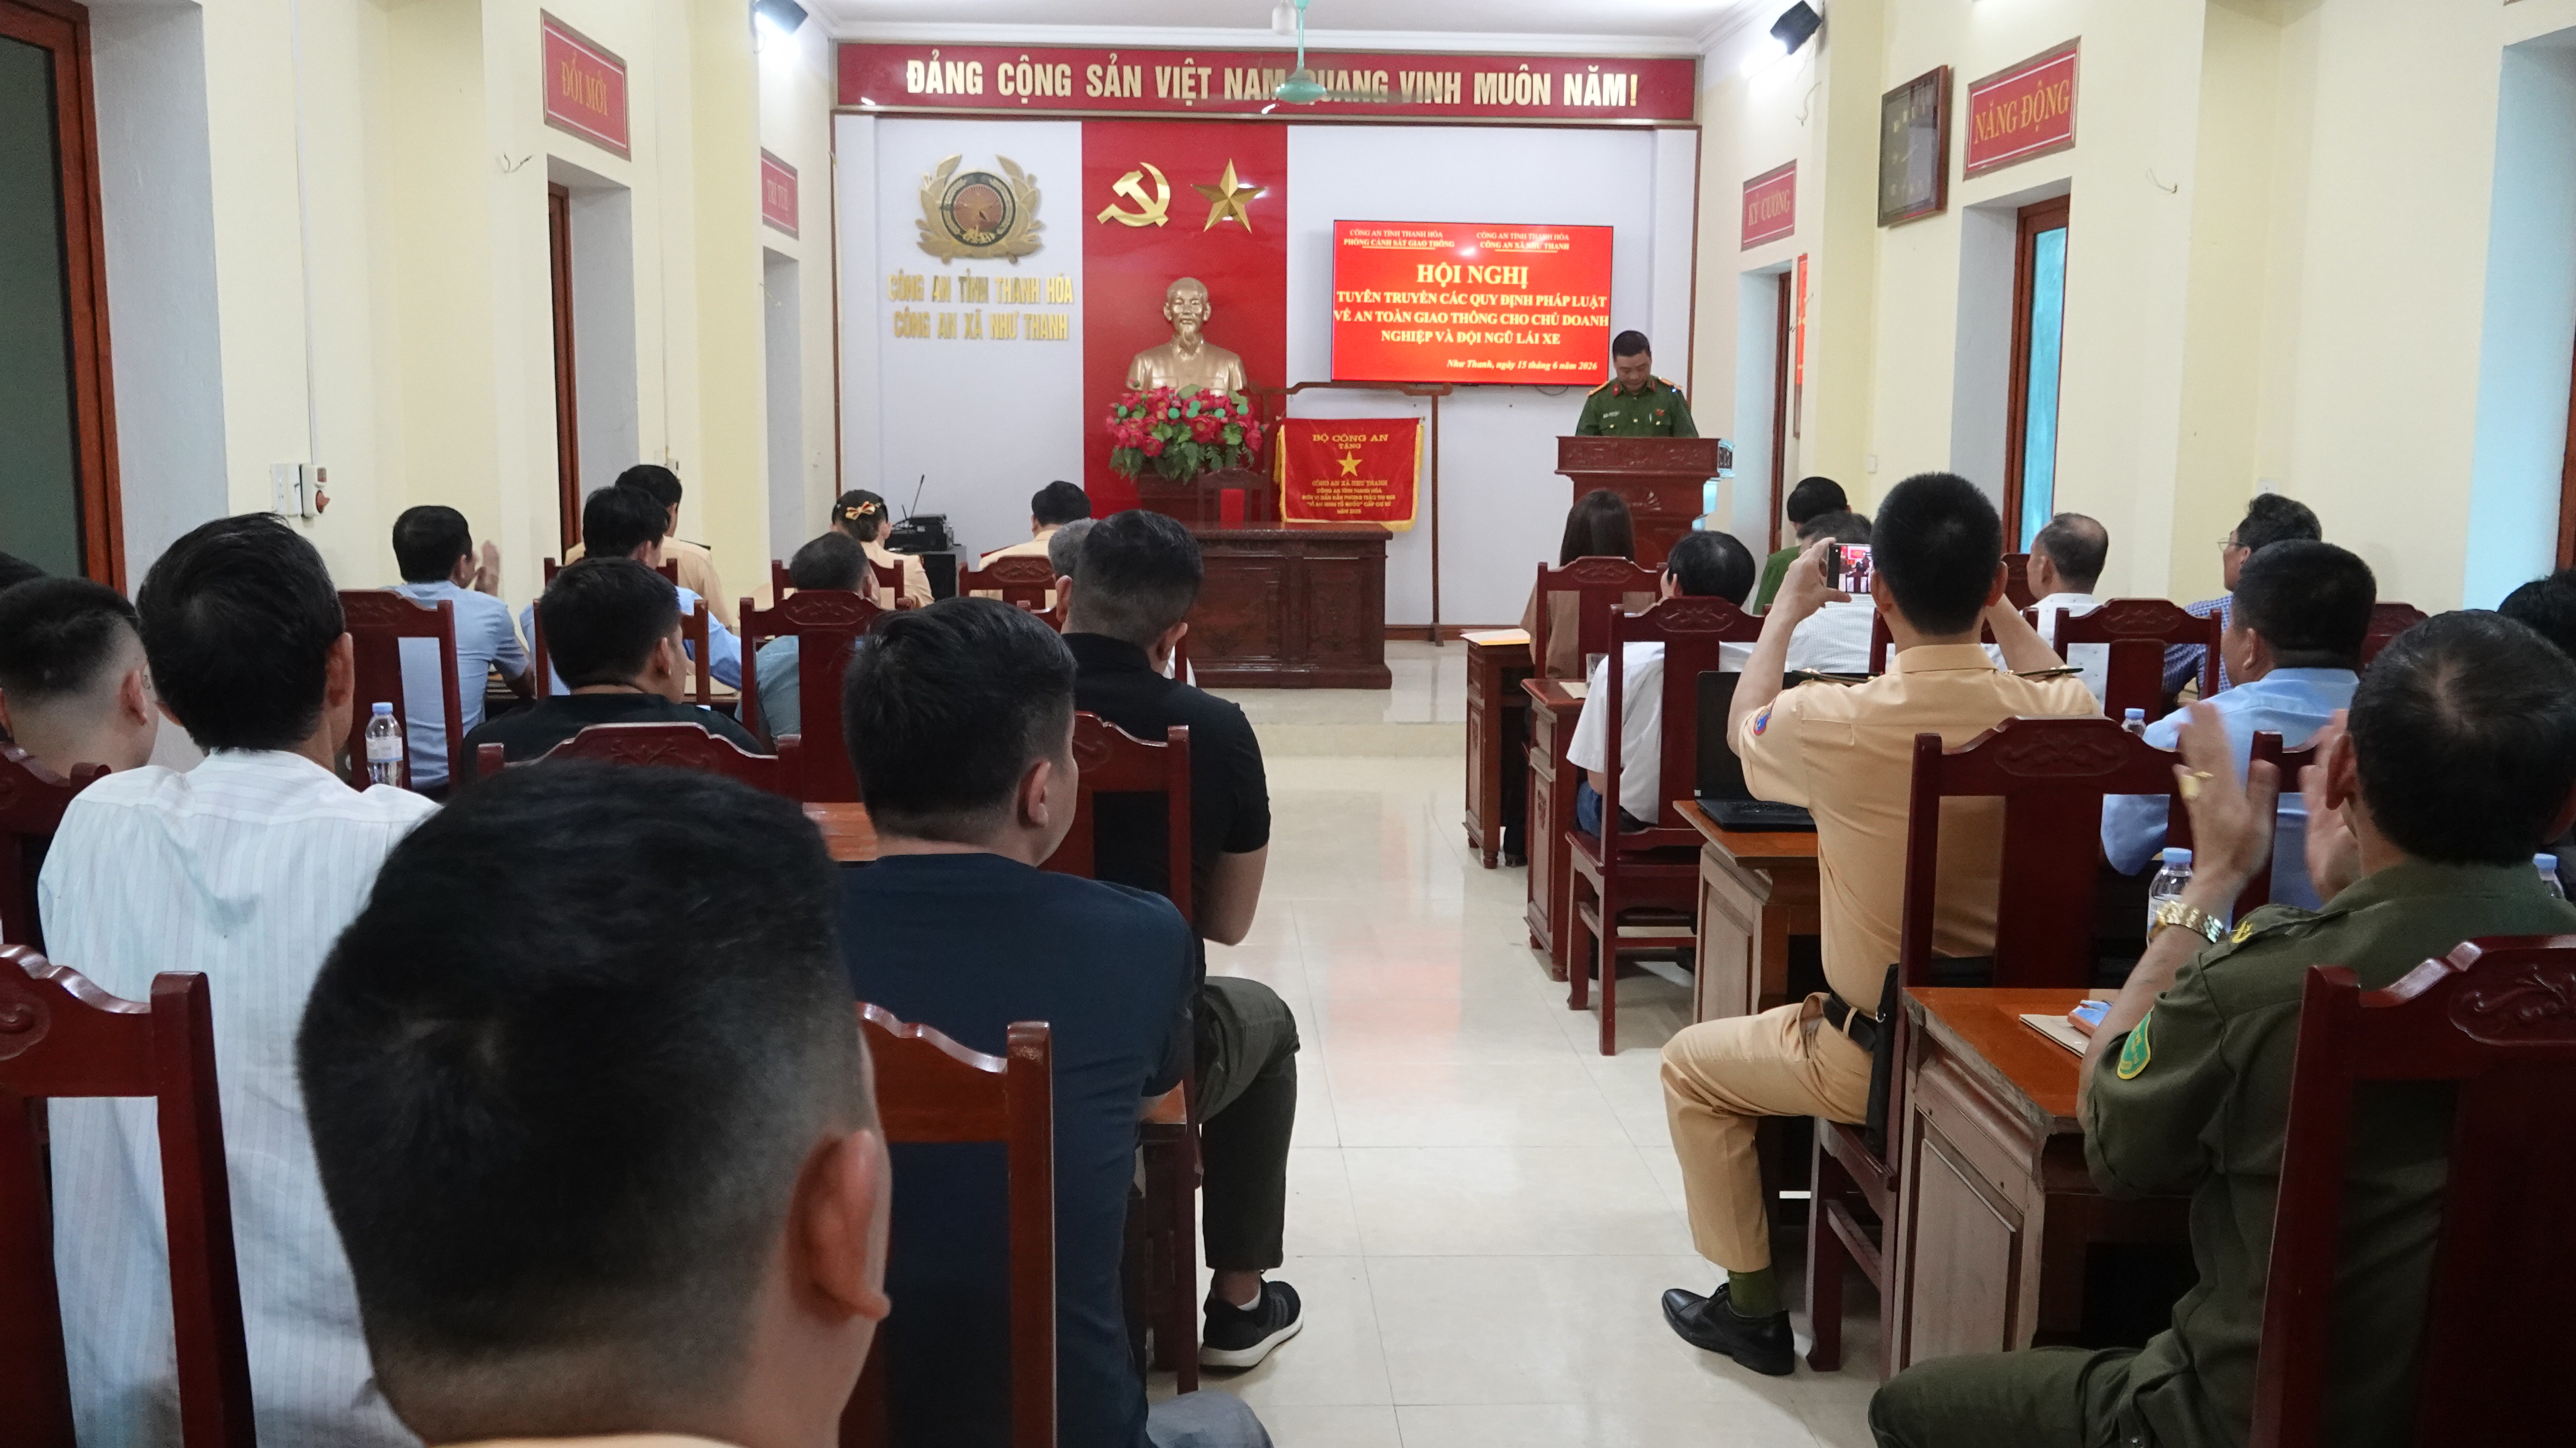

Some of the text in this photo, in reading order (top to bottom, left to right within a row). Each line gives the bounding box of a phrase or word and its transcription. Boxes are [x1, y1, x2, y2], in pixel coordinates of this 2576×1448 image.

[907, 49, 983, 94] ĐẢNG
[997, 54, 1072, 104] CỘNG
[1086, 52, 1142, 98] SẢN
[1155, 57, 1212, 106] VIỆT
[1224, 67, 1286, 100] NAM
[1399, 71, 1461, 104] VINH
[1474, 64, 1551, 106] MUÔN
[1563, 65, 1638, 107] NĂM!
[2021, 79, 2070, 132] ĐỘNG
[1350, 228, 1371, 236] CÔNG
[1401, 230, 1426, 238] THANH
[1371, 237, 1392, 246] CẢNH
[1393, 238, 1407, 246] SÁT
[1428, 239, 1455, 247] THÔNG
[1476, 231, 1497, 239] CÔNG
[1528, 232, 1553, 240] THANH
[1480, 240, 1501, 249] CÔNG
[1514, 240, 1525, 249] XÃ
[1417, 262, 1528, 289] HỘI NGHỊ
[888, 268, 924, 301] CÔNG
[932, 275, 951, 302] AN
[958, 268, 990, 303] TỈNH
[995, 276, 1041, 304] THANH
[1337, 289, 1607, 310] TUYÊN TRUYỀN CÁC QUY ĐỊNH PHÁP LUẬT
[894, 306, 1069, 340] CÔNG AN XÃ NHƯ THANH
[1334, 308, 1609, 327] VỀ AN TOÀN GIAO THÔNG CHO CHỦ DOANH
[1381, 328, 1560, 346] NGHIỆP VÀ ĐỘI NGŨ LÁI XE
[1447, 359, 1598, 371] Như Thanh, ngày 15 tháng 6 năm 2026
[1313, 433, 1329, 443] BỘ
[1332, 433, 1366, 442] CÔNG
